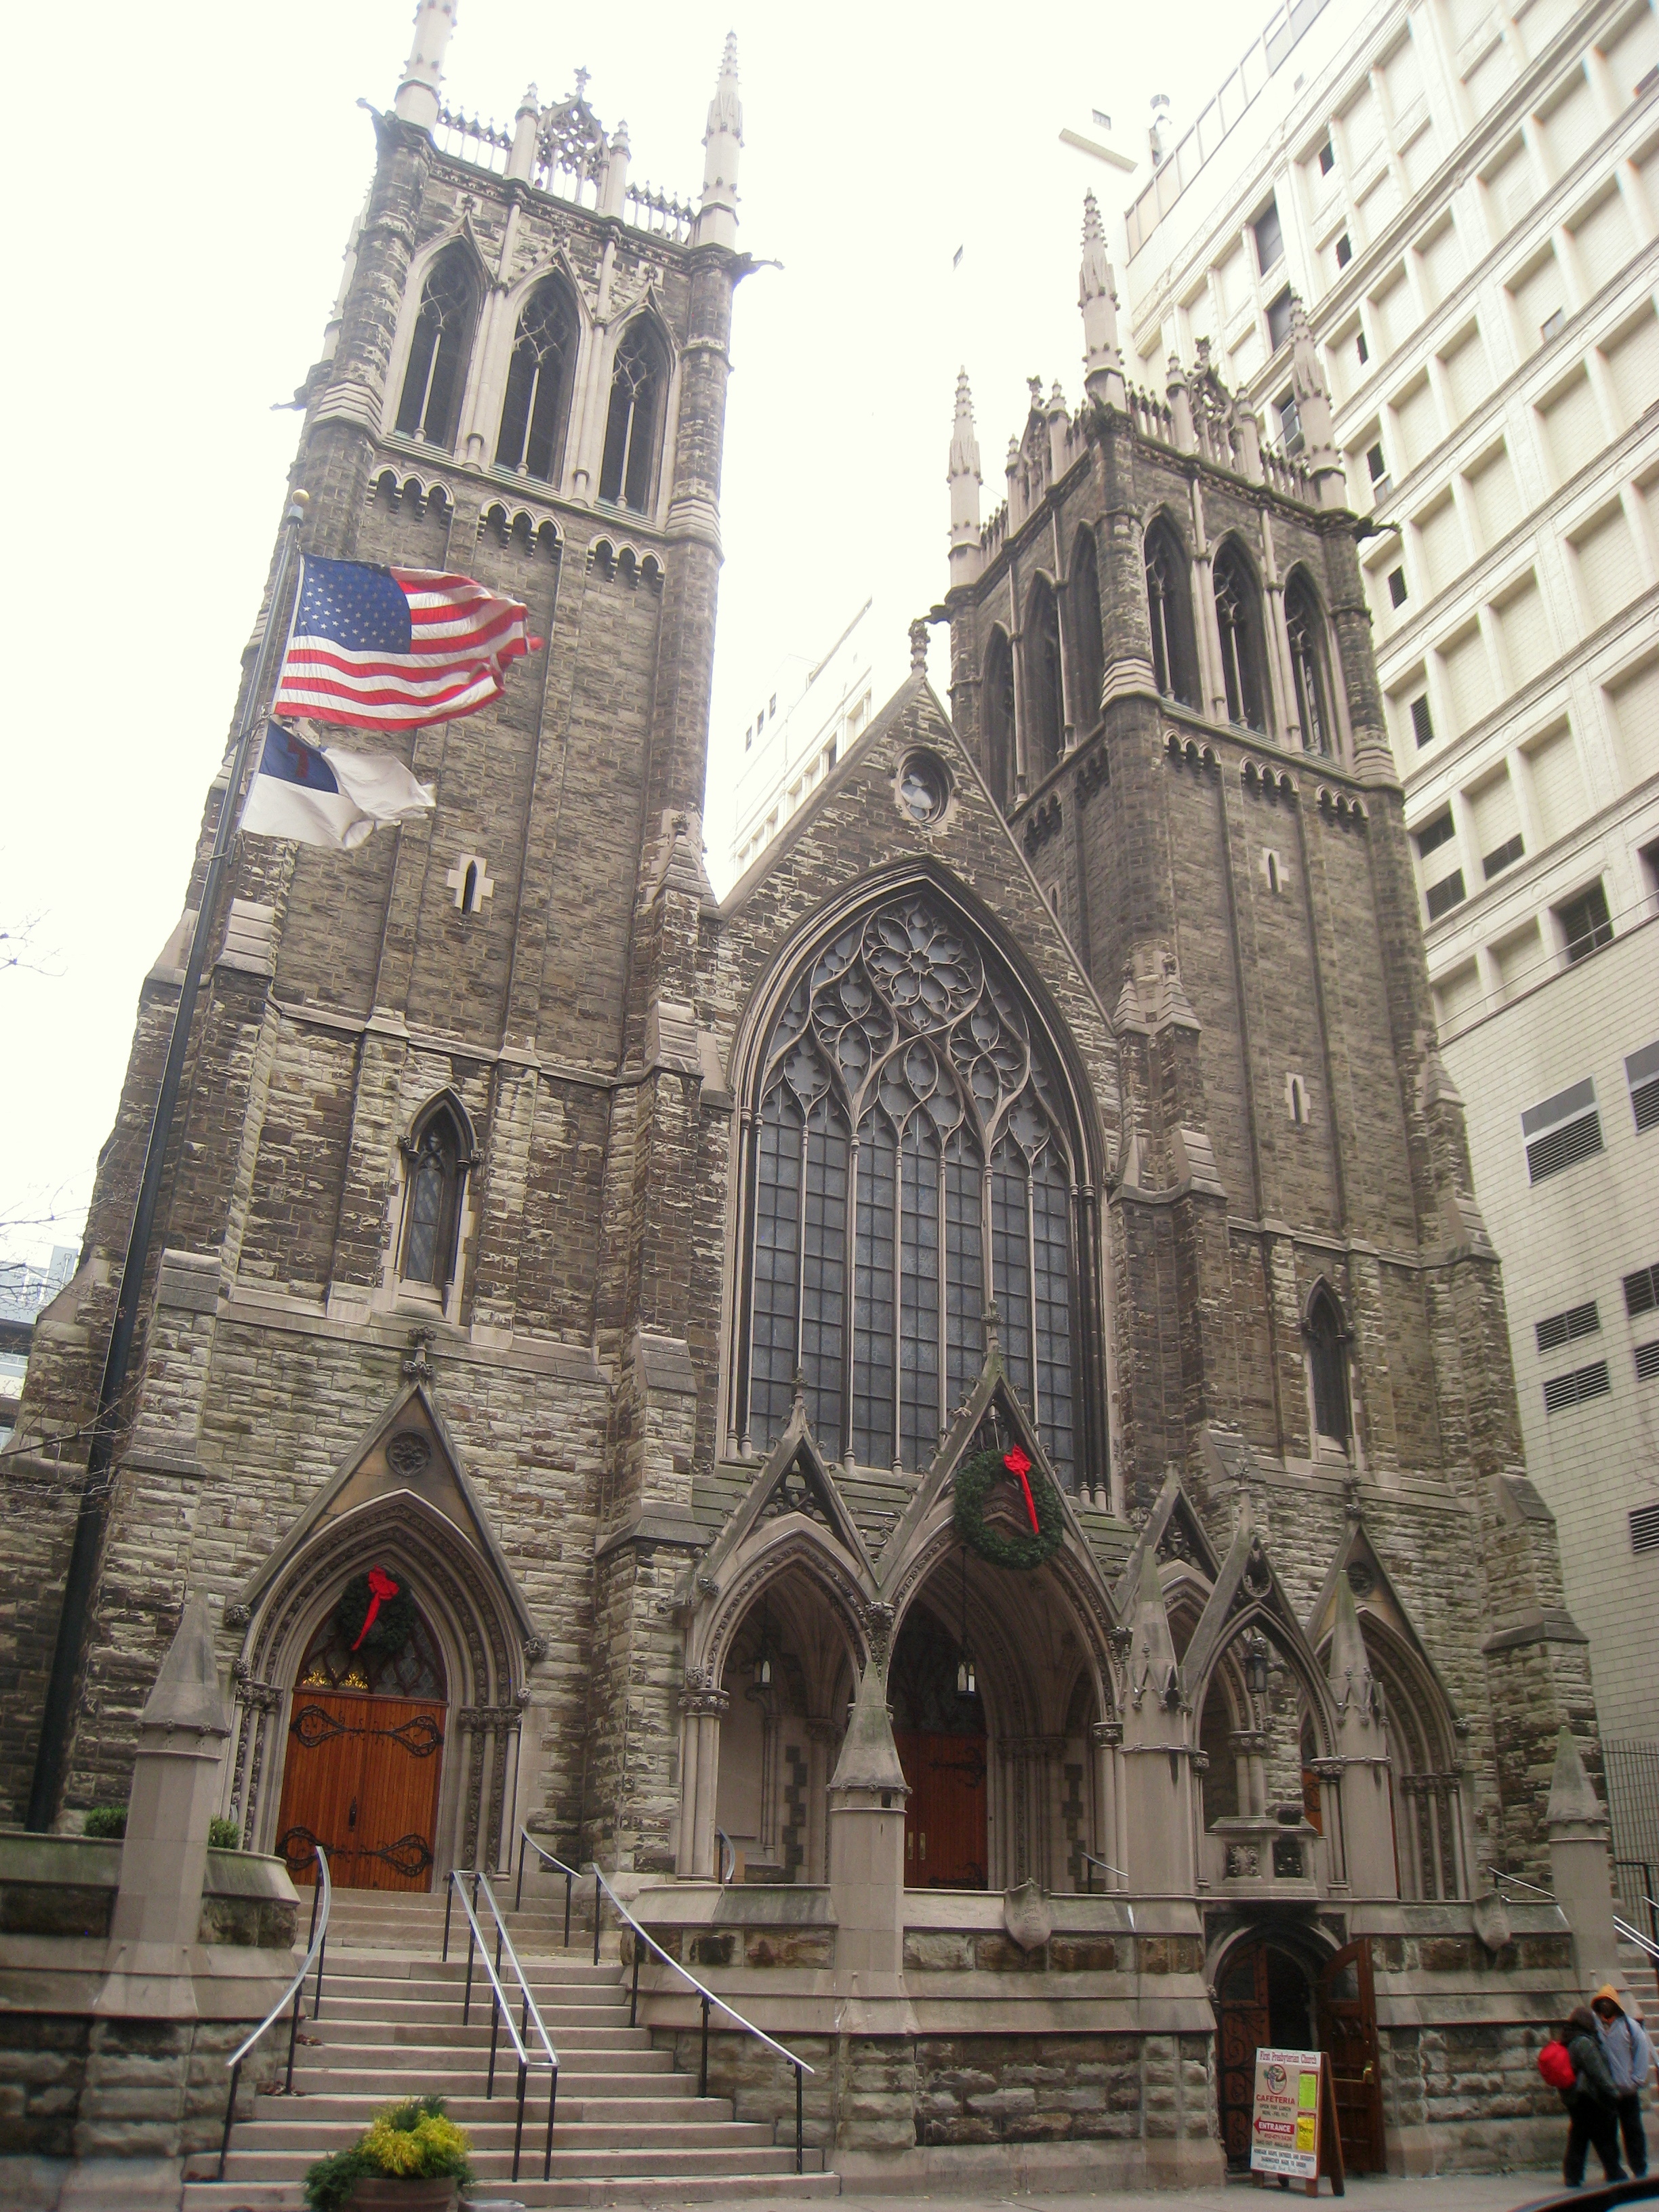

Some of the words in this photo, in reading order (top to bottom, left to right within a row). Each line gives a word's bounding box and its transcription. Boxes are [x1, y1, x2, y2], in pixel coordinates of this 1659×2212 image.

[1260, 2051, 1270, 2060] First
[1271, 2051, 1299, 2064] Presbyterian
[1301, 2053, 1316, 2064] Church
[1256, 2094, 1295, 2105] CAFETERIA
[1258, 2121, 1292, 2133] ENTRANCE
